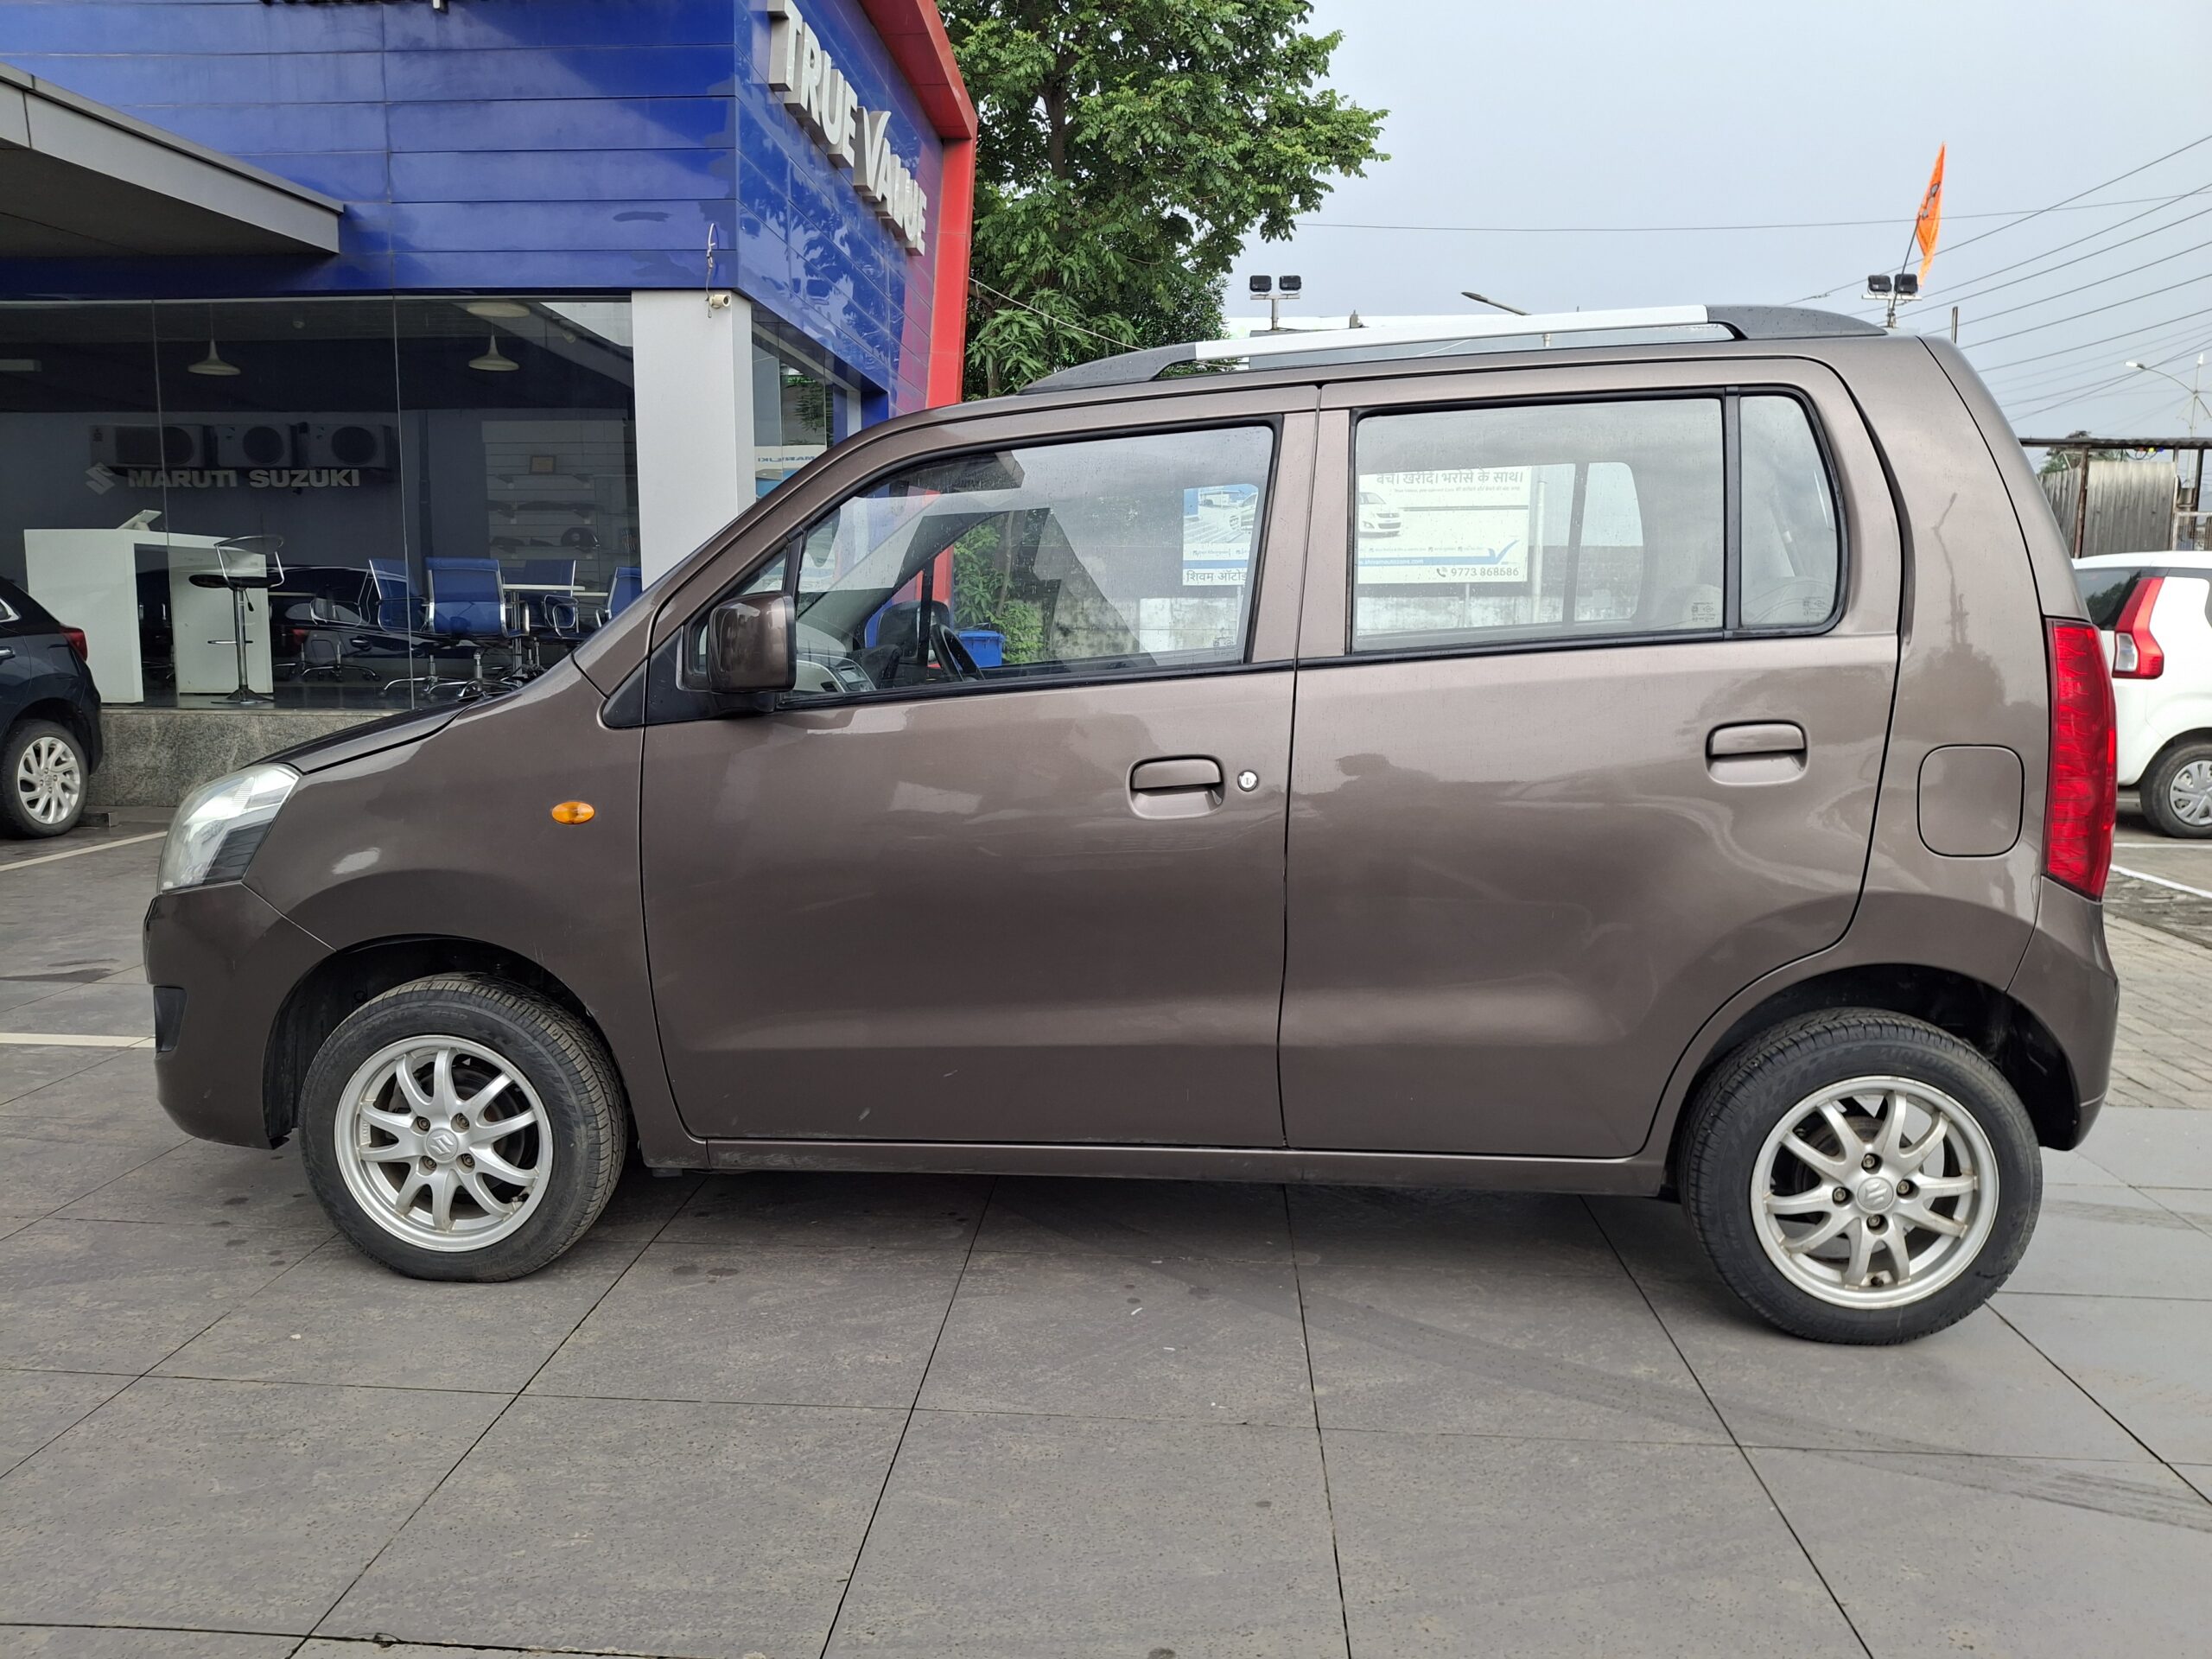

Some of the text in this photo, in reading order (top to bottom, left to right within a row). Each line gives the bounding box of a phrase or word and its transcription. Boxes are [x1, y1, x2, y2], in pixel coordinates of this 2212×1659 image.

[769, 0, 928, 257] TRUE VALUE
[127, 468, 361, 488] MARUTI SUZUKI
[1185, 569, 1214, 582] शिवम
[1451, 567, 1478, 576] 9773
